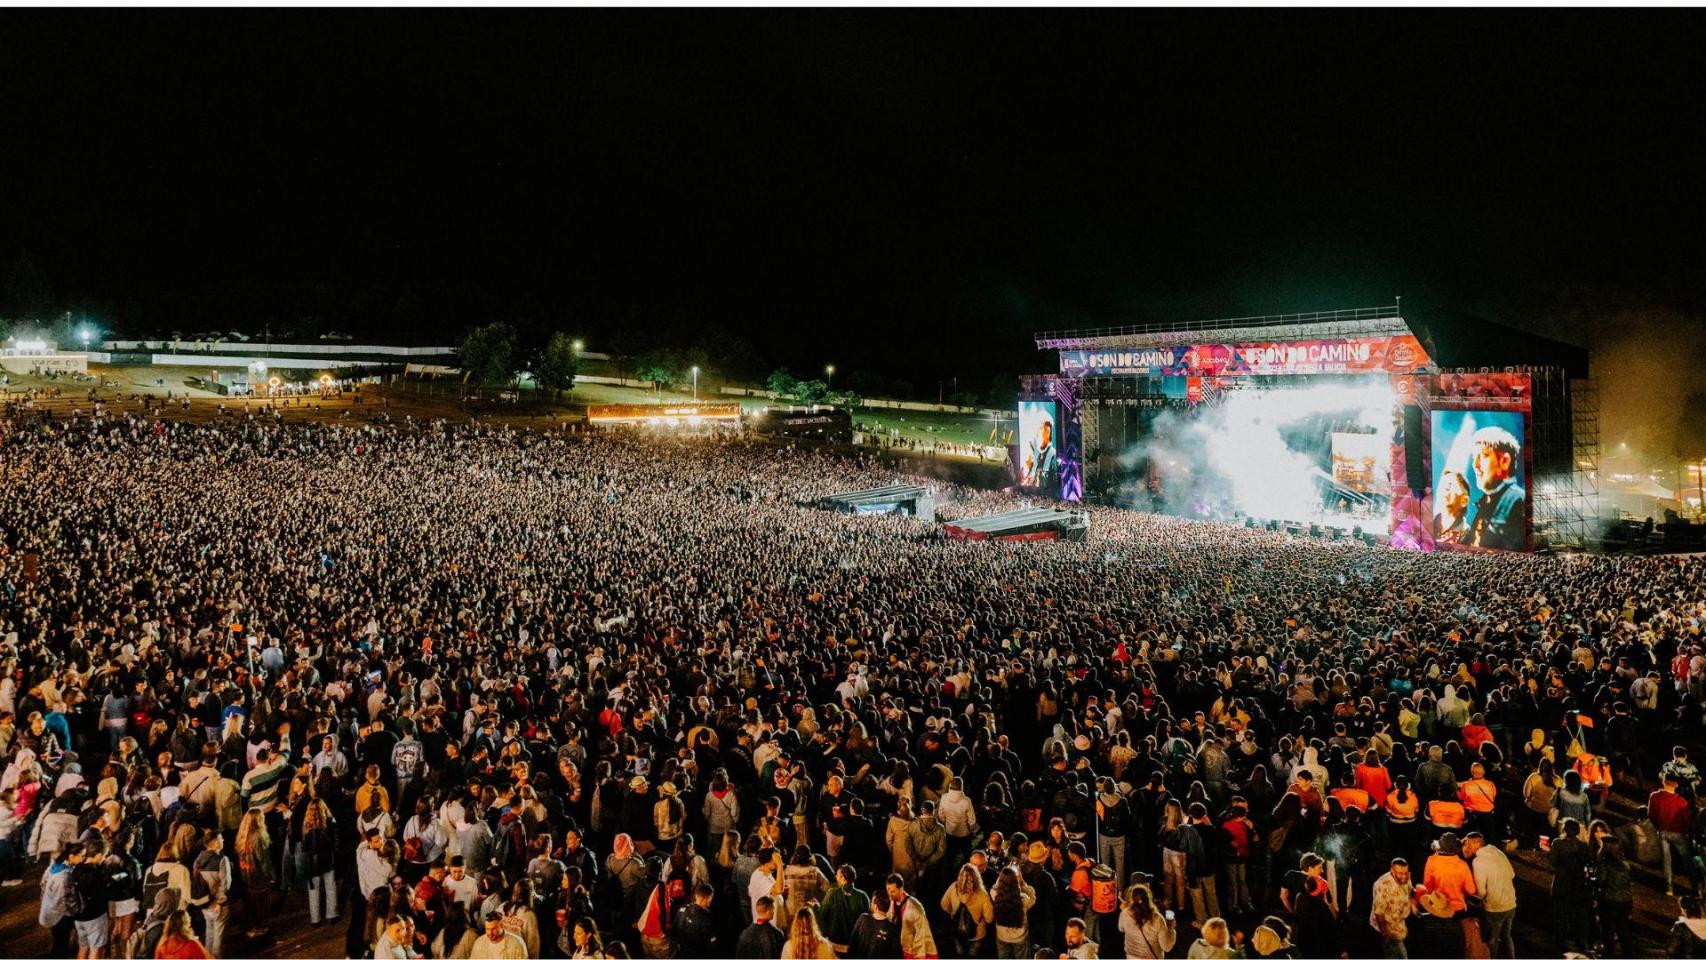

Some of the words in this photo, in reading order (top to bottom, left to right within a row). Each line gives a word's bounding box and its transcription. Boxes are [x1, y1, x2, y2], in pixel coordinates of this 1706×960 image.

[1097, 353, 1117, 368] SON
[1118, 352, 1132, 367] DO
[1133, 348, 1175, 367] CAMIÑO
[1309, 339, 1370, 361] CAMIÑO
